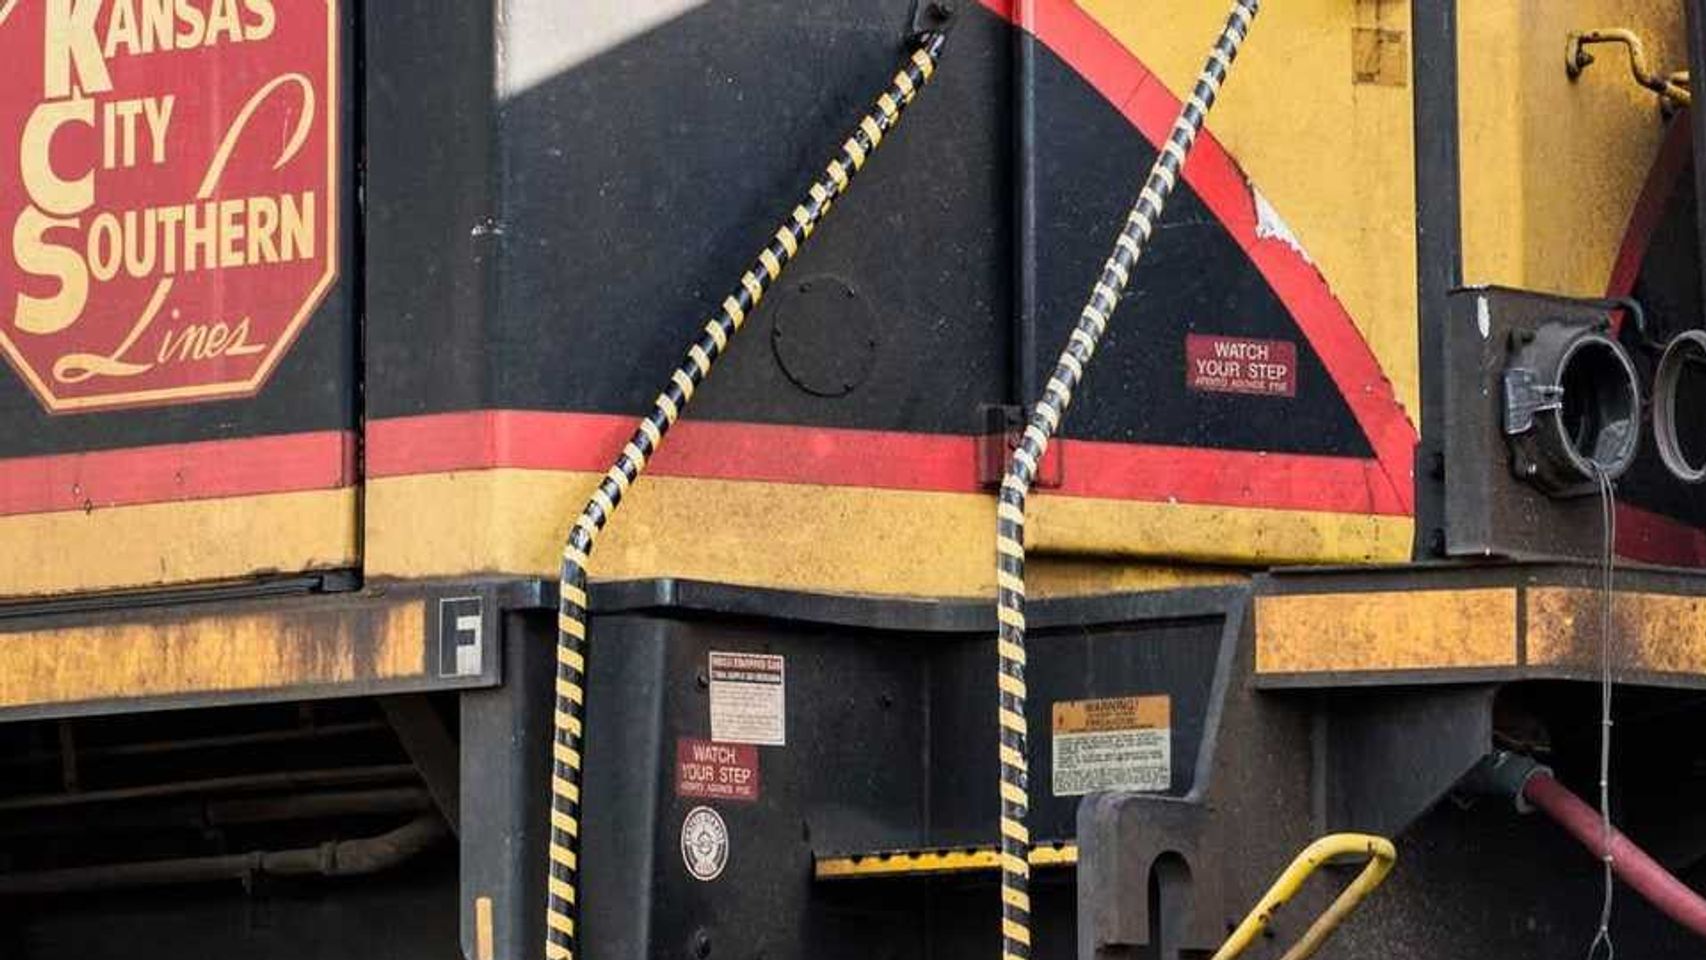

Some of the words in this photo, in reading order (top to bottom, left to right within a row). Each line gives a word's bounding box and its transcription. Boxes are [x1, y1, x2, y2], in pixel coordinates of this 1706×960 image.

[44, 0, 277, 98] KANSAS
[20, 94, 175, 214] CITY
[12, 191, 315, 335] SOUTHERN
[1214, 341, 1269, 360] WATCH
[1195, 358, 1240, 377] YOUR
[1248, 362, 1288, 380] STEP
[693, 742, 737, 764] WATCH
[682, 762, 714, 781] YOUR
[719, 767, 751, 784] STEP
